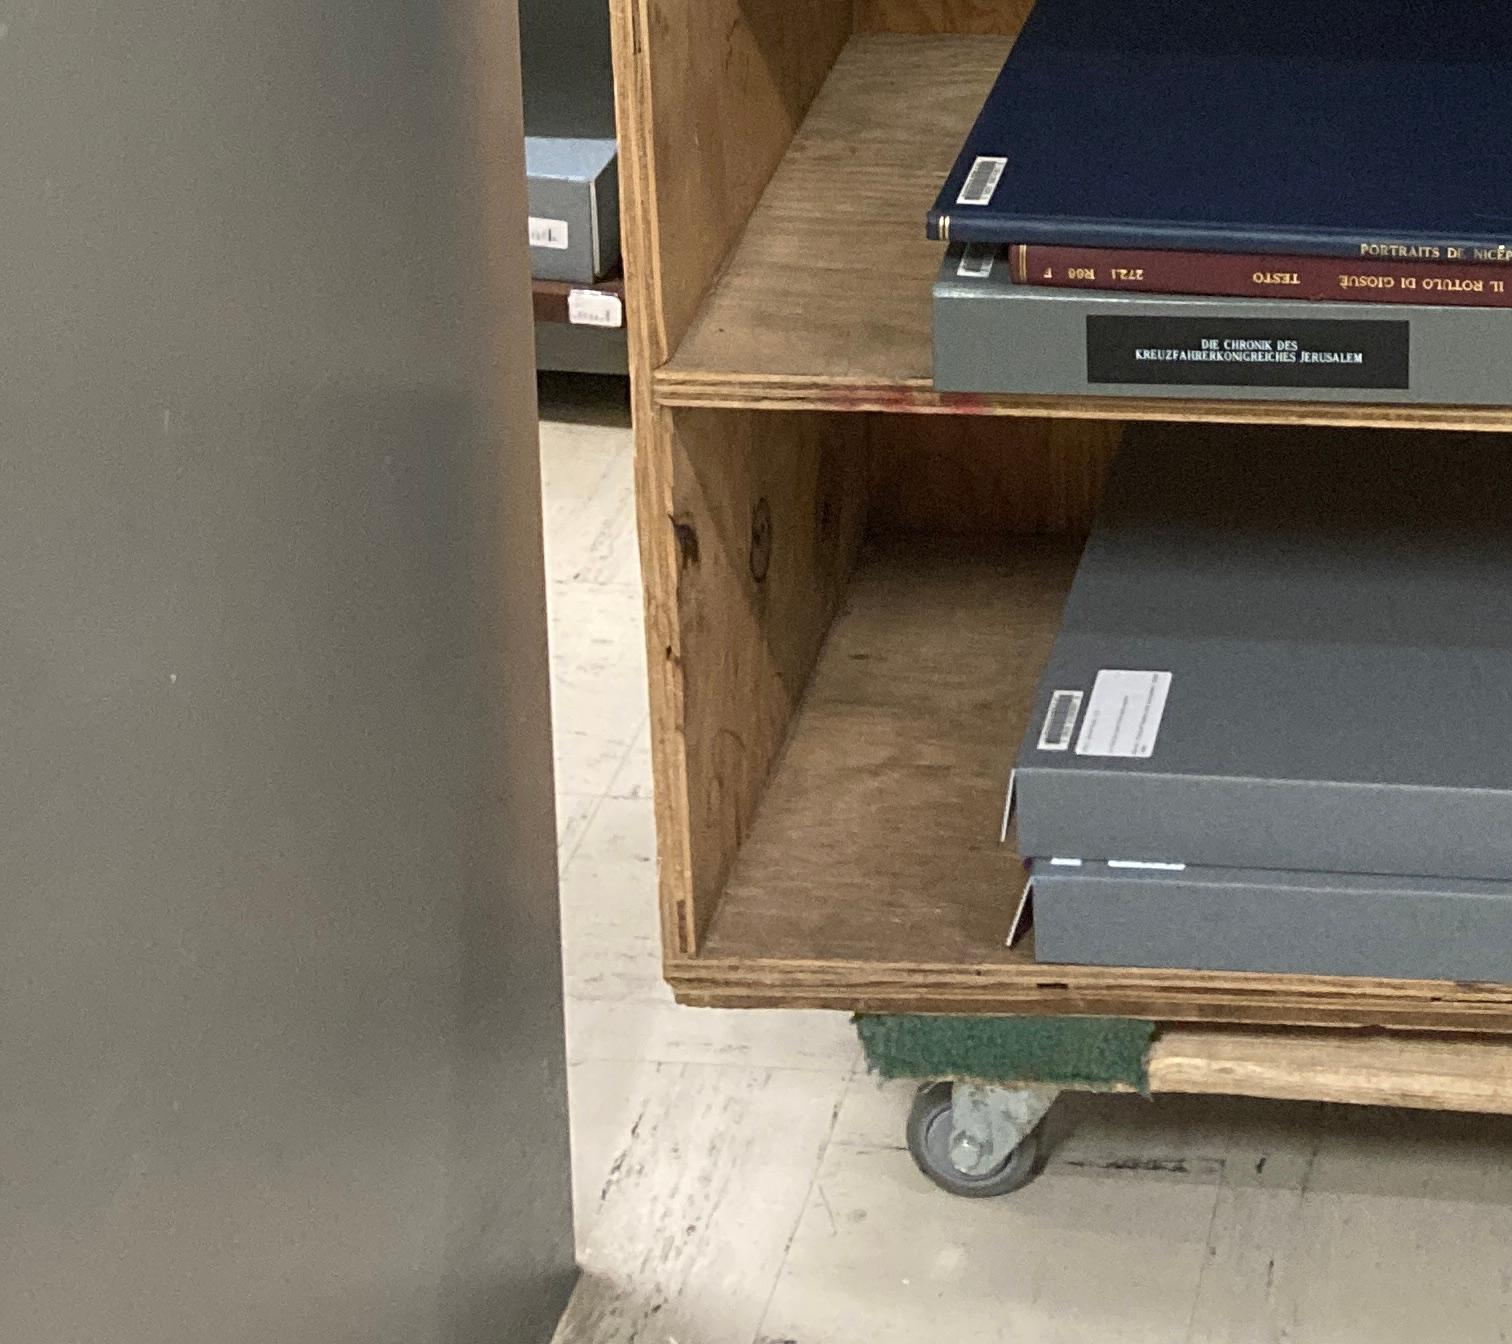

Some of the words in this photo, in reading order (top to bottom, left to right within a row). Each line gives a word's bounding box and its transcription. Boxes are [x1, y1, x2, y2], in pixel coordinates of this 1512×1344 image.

[1360, 243, 1440, 258] PORTRAITS
[1043, 268, 1052, 278] F
[1253, 272, 1301, 285] TESTO
[1401, 277, 1416, 288] DI
[1422, 278, 1483, 291] ROTULO
[1490, 281, 1504, 292] IL
[1201, 339, 1219, 349] DIE
[1223, 340, 1272, 350] CHRONIK
[1277, 340, 1297, 351] DES
[1299, 351, 1362, 363] JERUSALEM
